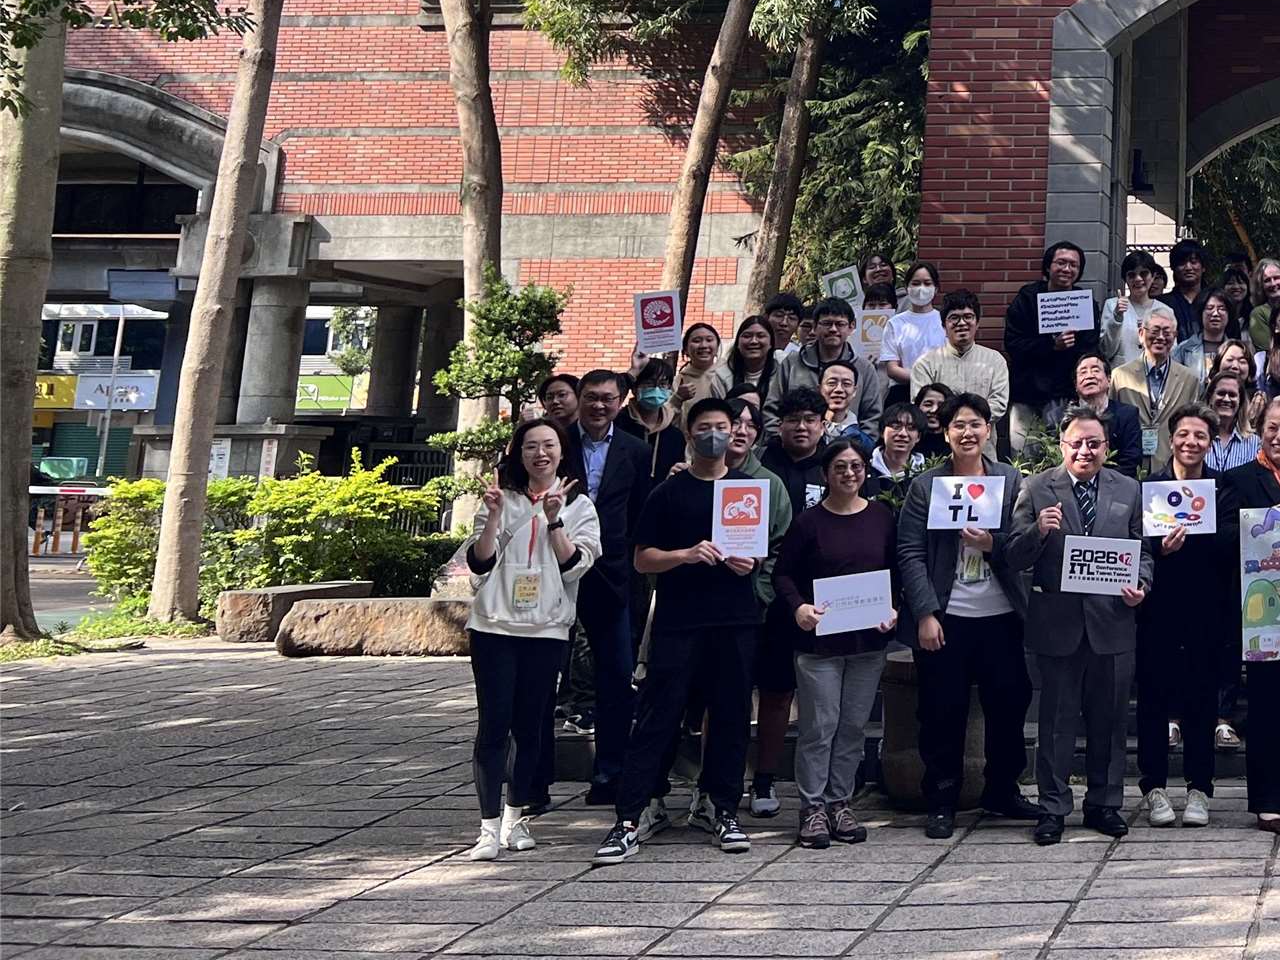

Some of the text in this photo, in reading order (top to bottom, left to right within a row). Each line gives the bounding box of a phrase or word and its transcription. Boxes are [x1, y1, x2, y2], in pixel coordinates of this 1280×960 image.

[952, 483, 963, 499] I
[1070, 549, 1118, 564] 2026
[1069, 562, 1095, 575] ITL
